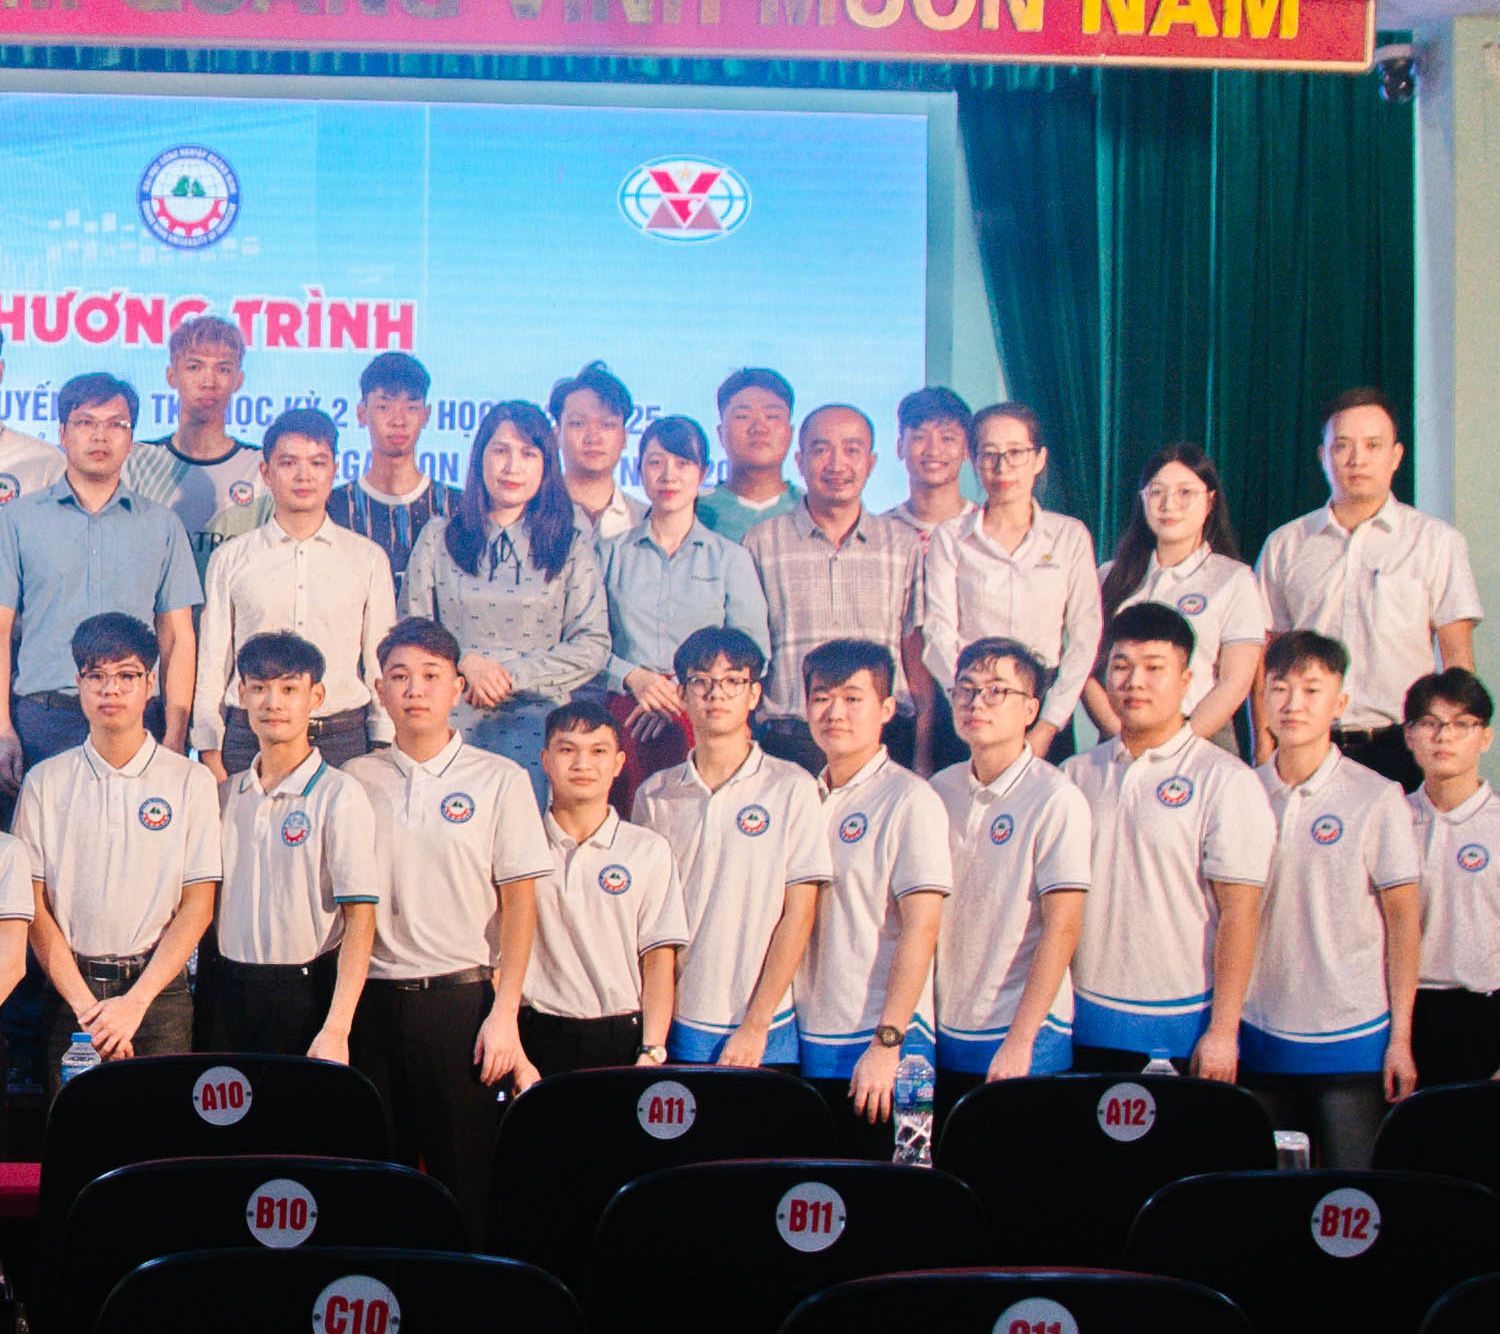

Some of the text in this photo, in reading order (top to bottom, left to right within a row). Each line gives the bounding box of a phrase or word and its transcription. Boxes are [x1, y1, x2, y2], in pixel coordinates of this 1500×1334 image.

[232, 286, 415, 350] TRÌNH
[331, 397, 349, 428] 2
[201, 1081, 244, 1111] A10
[1106, 1098, 1147, 1126] A12
[256, 1196, 307, 1230] B10
[789, 1199, 832, 1233] B11
